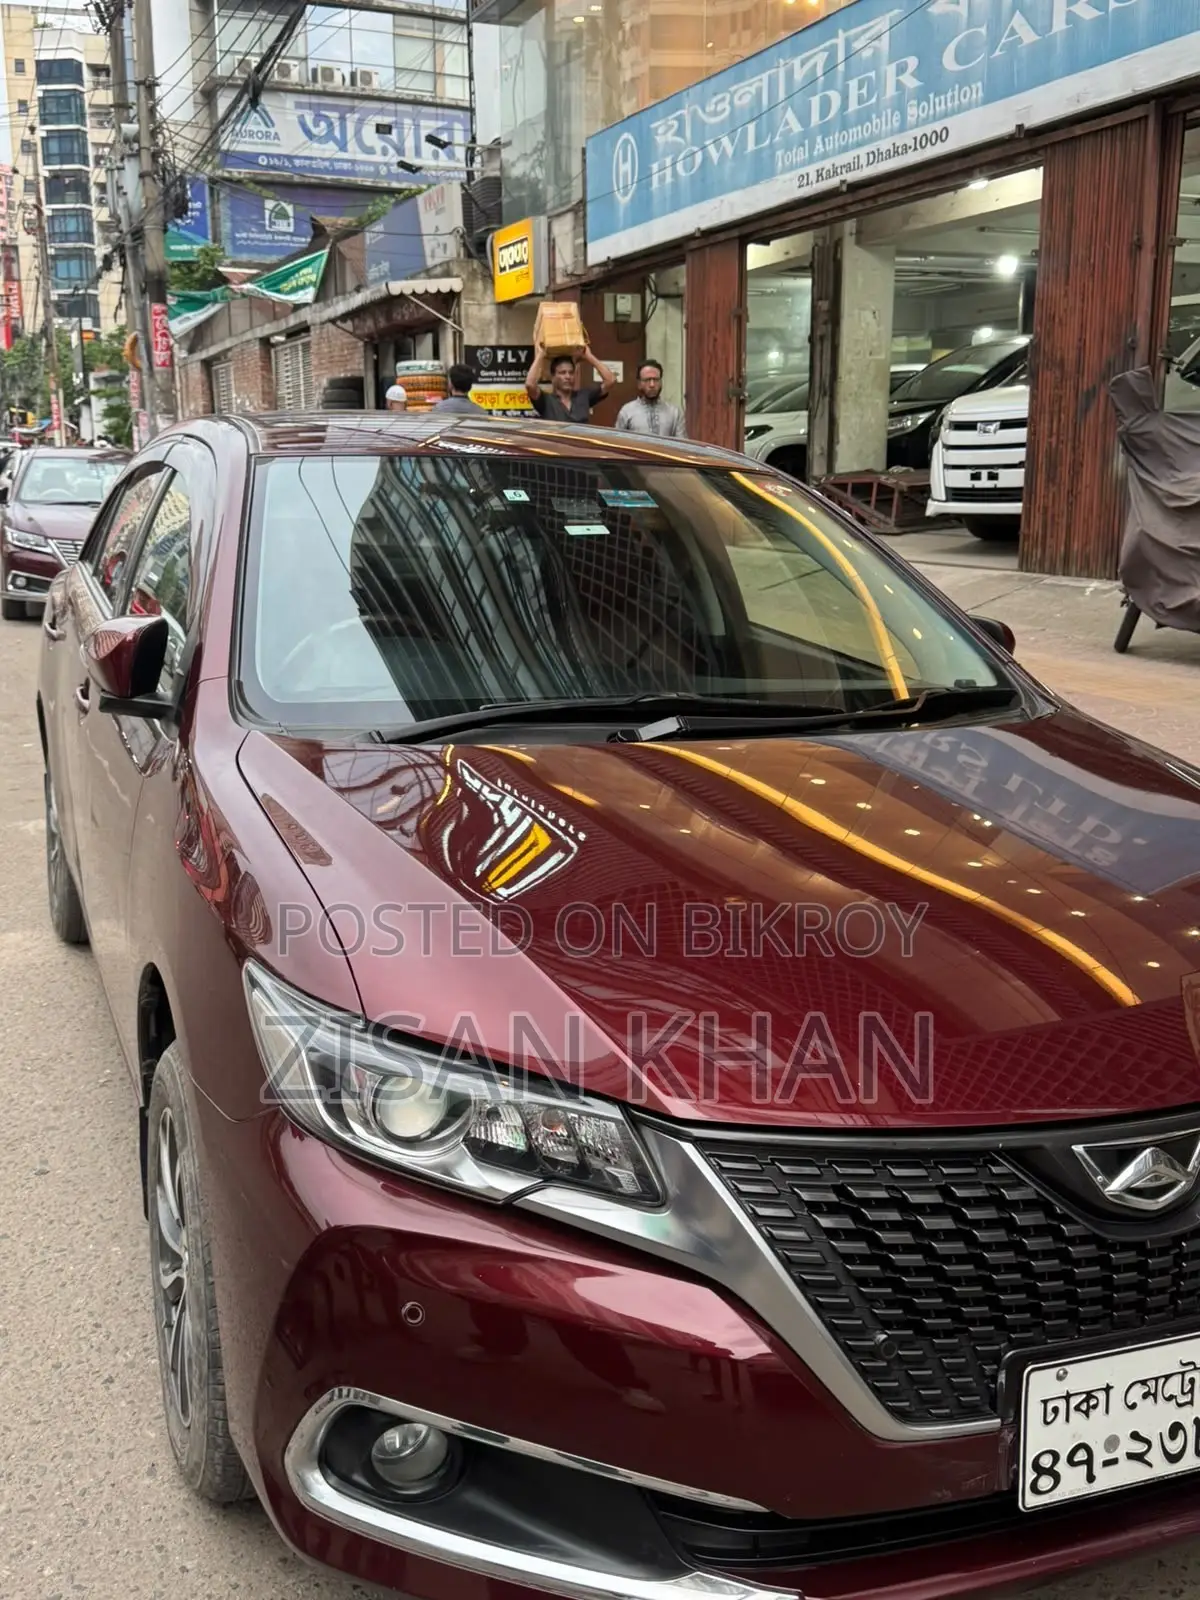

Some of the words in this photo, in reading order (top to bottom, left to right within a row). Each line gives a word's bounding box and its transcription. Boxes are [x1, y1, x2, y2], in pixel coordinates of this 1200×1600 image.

[650, 9, 904, 146] হাওলাদার
[650, 54, 925, 191] HOWLADER
[942, 0, 1139, 72] CAR
[775, 139, 809, 169] Total
[813, 108, 901, 156] Automobile
[907, 81, 984, 126] Solution
[797, 171, 815, 189] 21,
[815, 154, 864, 184] Kakrail,
[866, 126, 950, 166] Dhaka-1000
[497, 350, 528, 363] FLY
[1040, 1383, 1114, 1425] ঢাকা
[1030, 1416, 1200, 1496] ৪৭-২৩
